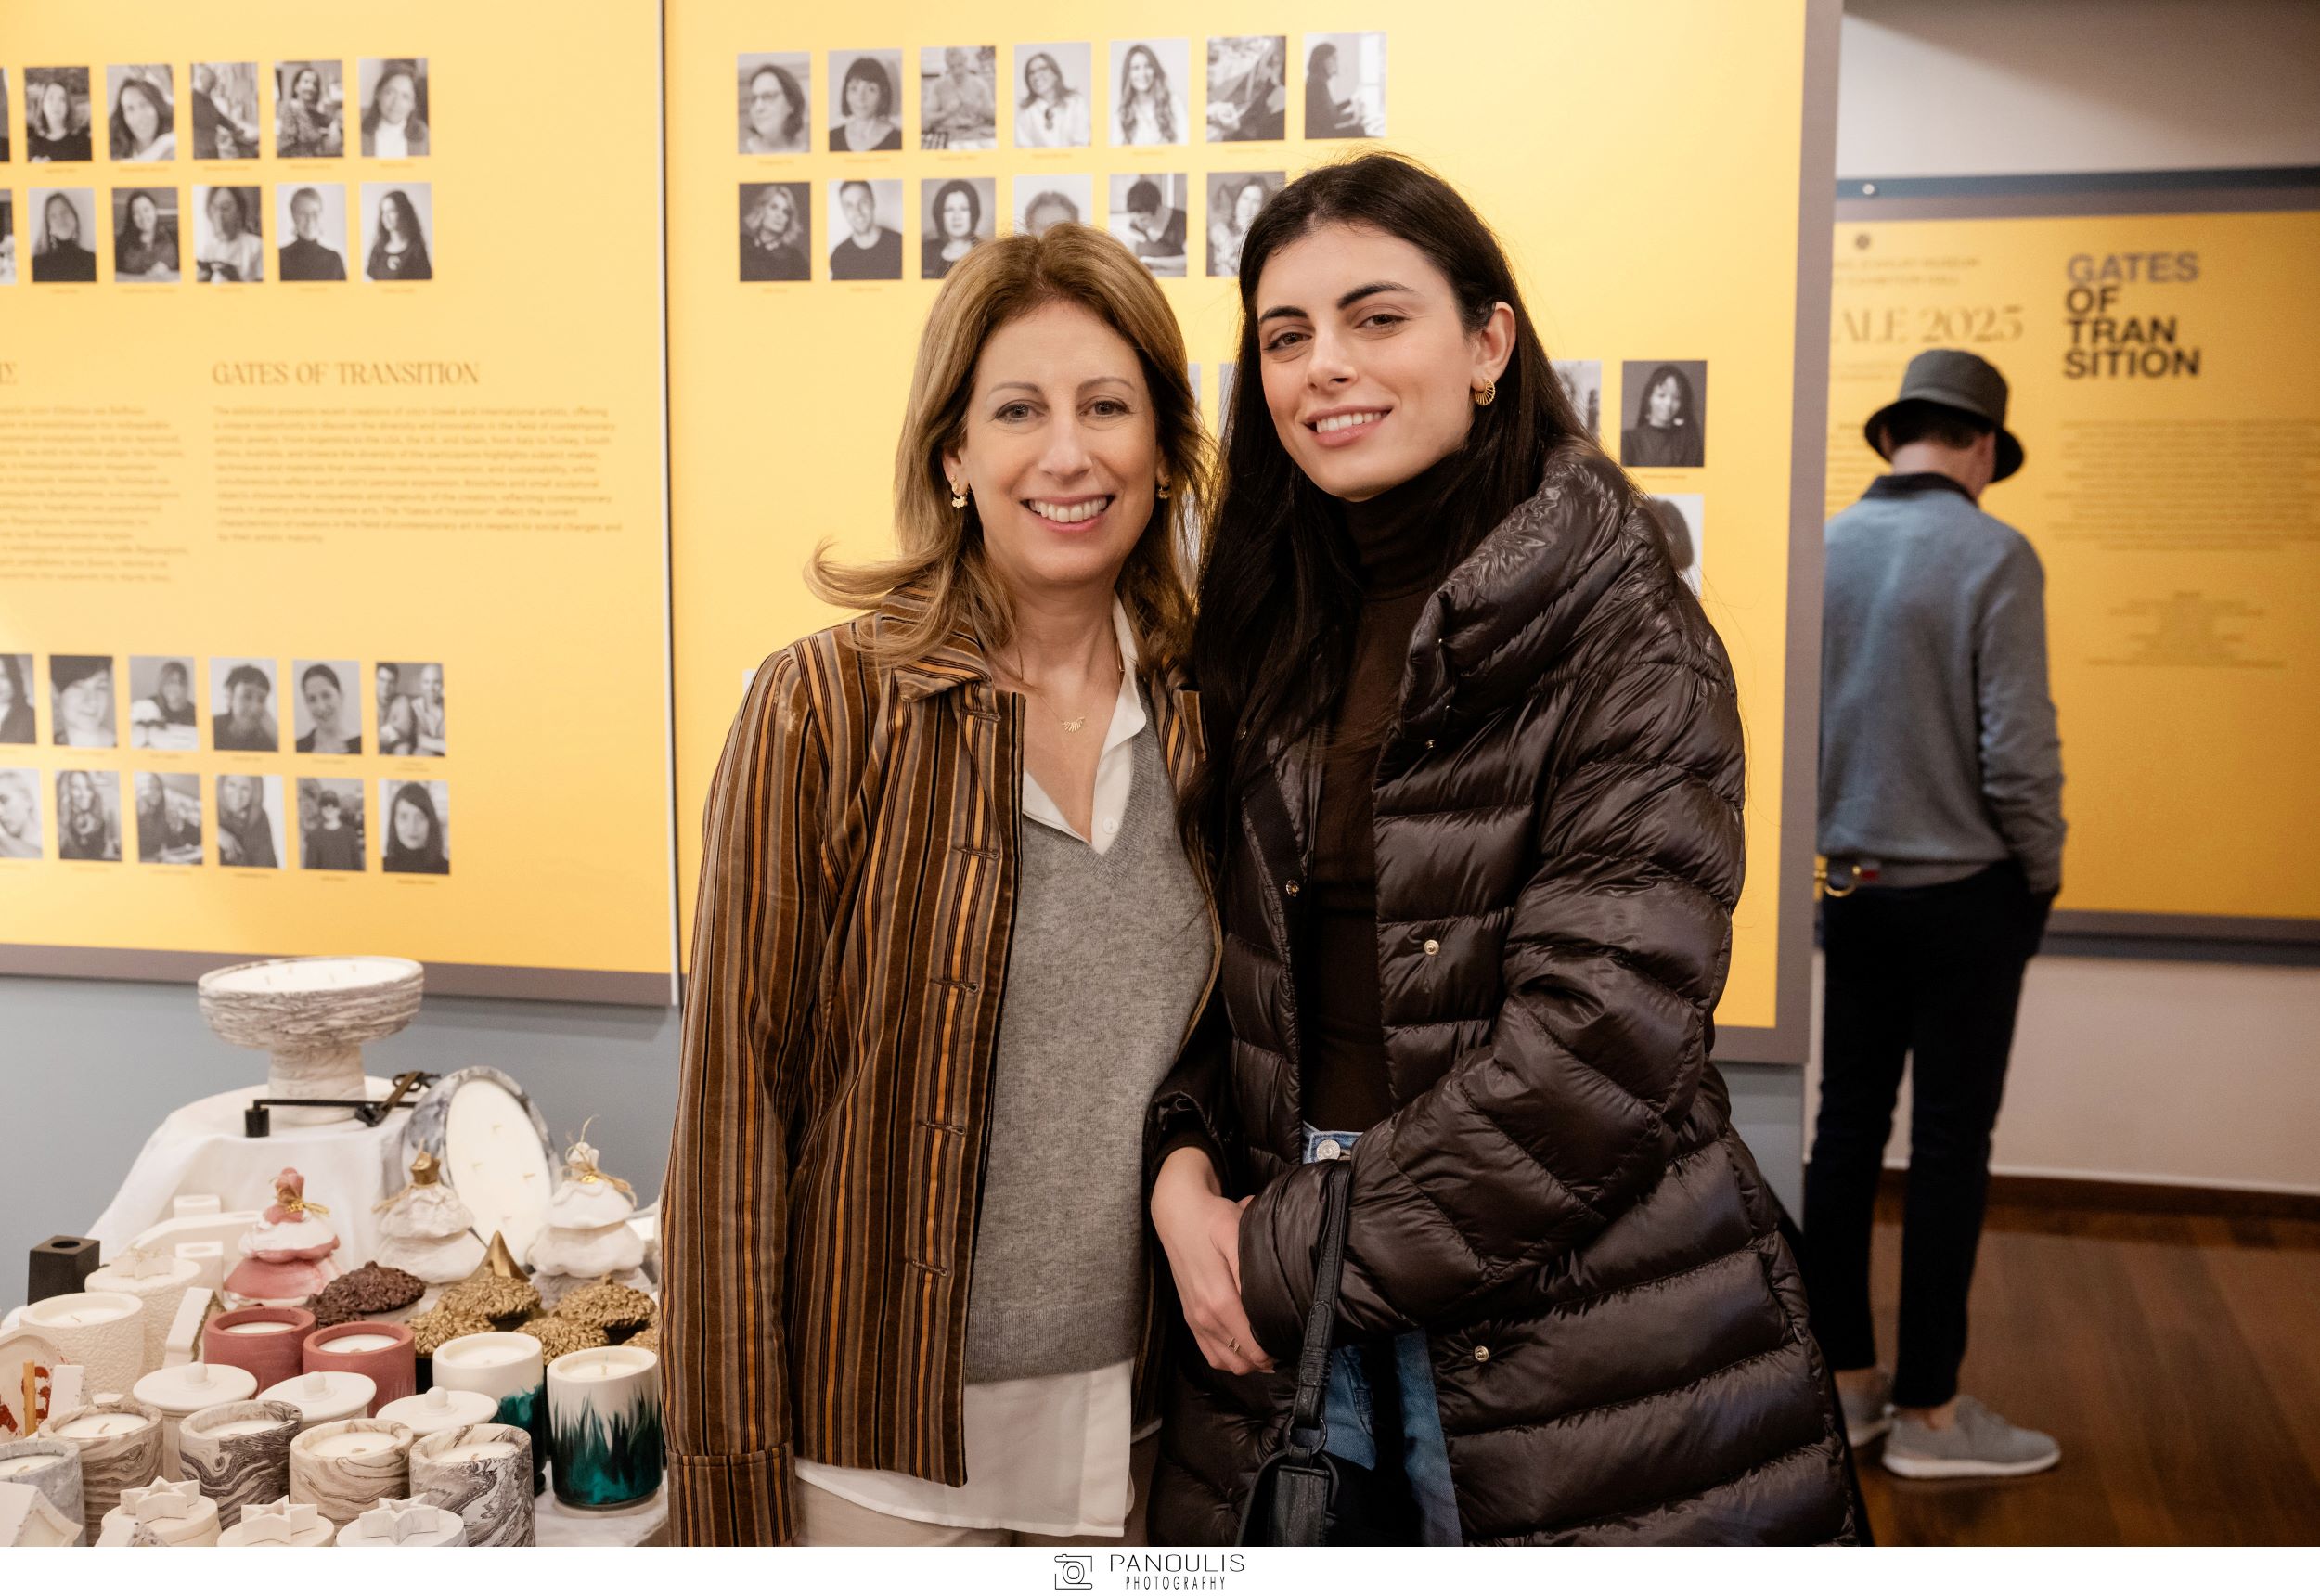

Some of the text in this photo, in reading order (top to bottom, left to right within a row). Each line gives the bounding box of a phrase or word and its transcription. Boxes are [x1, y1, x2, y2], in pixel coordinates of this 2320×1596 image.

[2067, 251, 2198, 283] GATES
[2065, 284, 2120, 315] OF
[1918, 304, 2024, 343] 2025
[2066, 316, 2177, 345] TRAN
[212, 361, 480, 386] GATES OF TRANSITION
[2063, 347, 2200, 379] SITION
